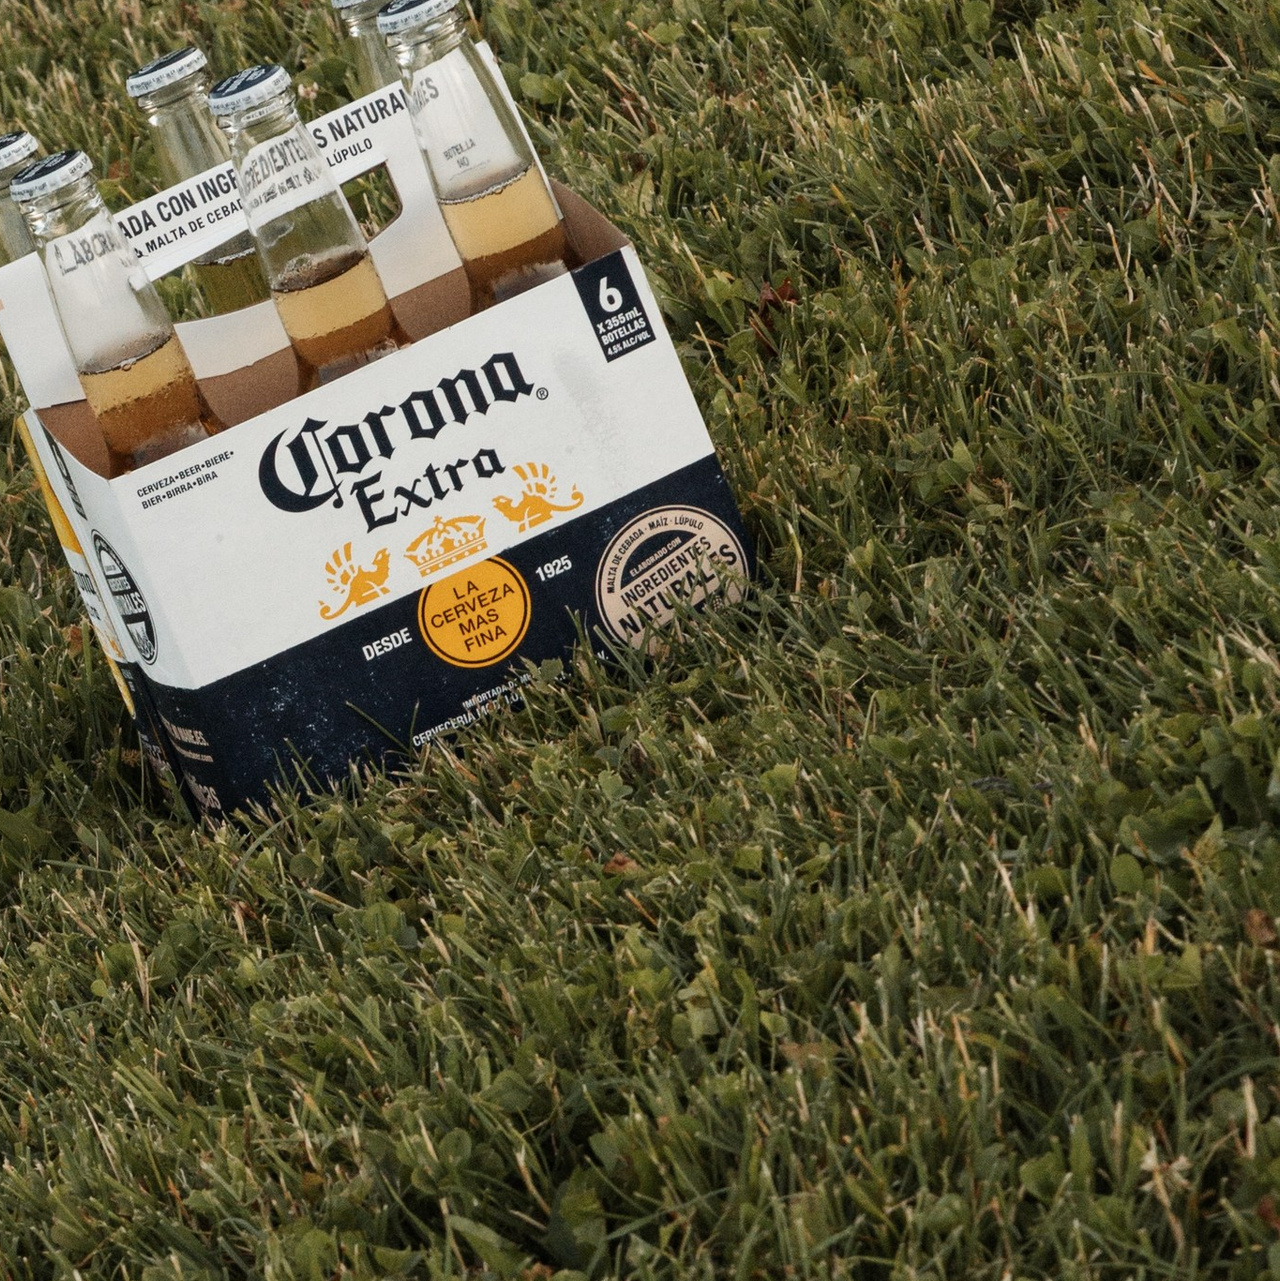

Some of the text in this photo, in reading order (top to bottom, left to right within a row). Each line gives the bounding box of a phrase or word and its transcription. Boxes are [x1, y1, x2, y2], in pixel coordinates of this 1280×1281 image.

[145, 225, 188, 253] MALTA
[189, 216, 206, 233] DE
[326, 137, 373, 168] LÚPULO
[157, 189, 197, 222] CON
[599, 276, 623, 313] 6
[601, 317, 647, 346] BOTELLAS
[605, 306, 642, 331] 355mL
[607, 330, 651, 355] 4.5% ALC/VOL
[259, 352, 535, 513] Corona
[350, 448, 506, 534] Extra
[607, 514, 704, 594] MALTA DE CEBADA MAÍZ LÚPULO
[620, 535, 712, 608] INGREDIENTES
[629, 536, 683, 578] ELABORADO CON
[361, 554, 573, 662] DESDE 1925
[431, 582, 515, 628] CERVEZA
[453, 580, 479, 600] LA
[458, 608, 499, 636] MAS
[464, 625, 507, 653] FINA
[462, 686, 508, 710] IMORTADA
